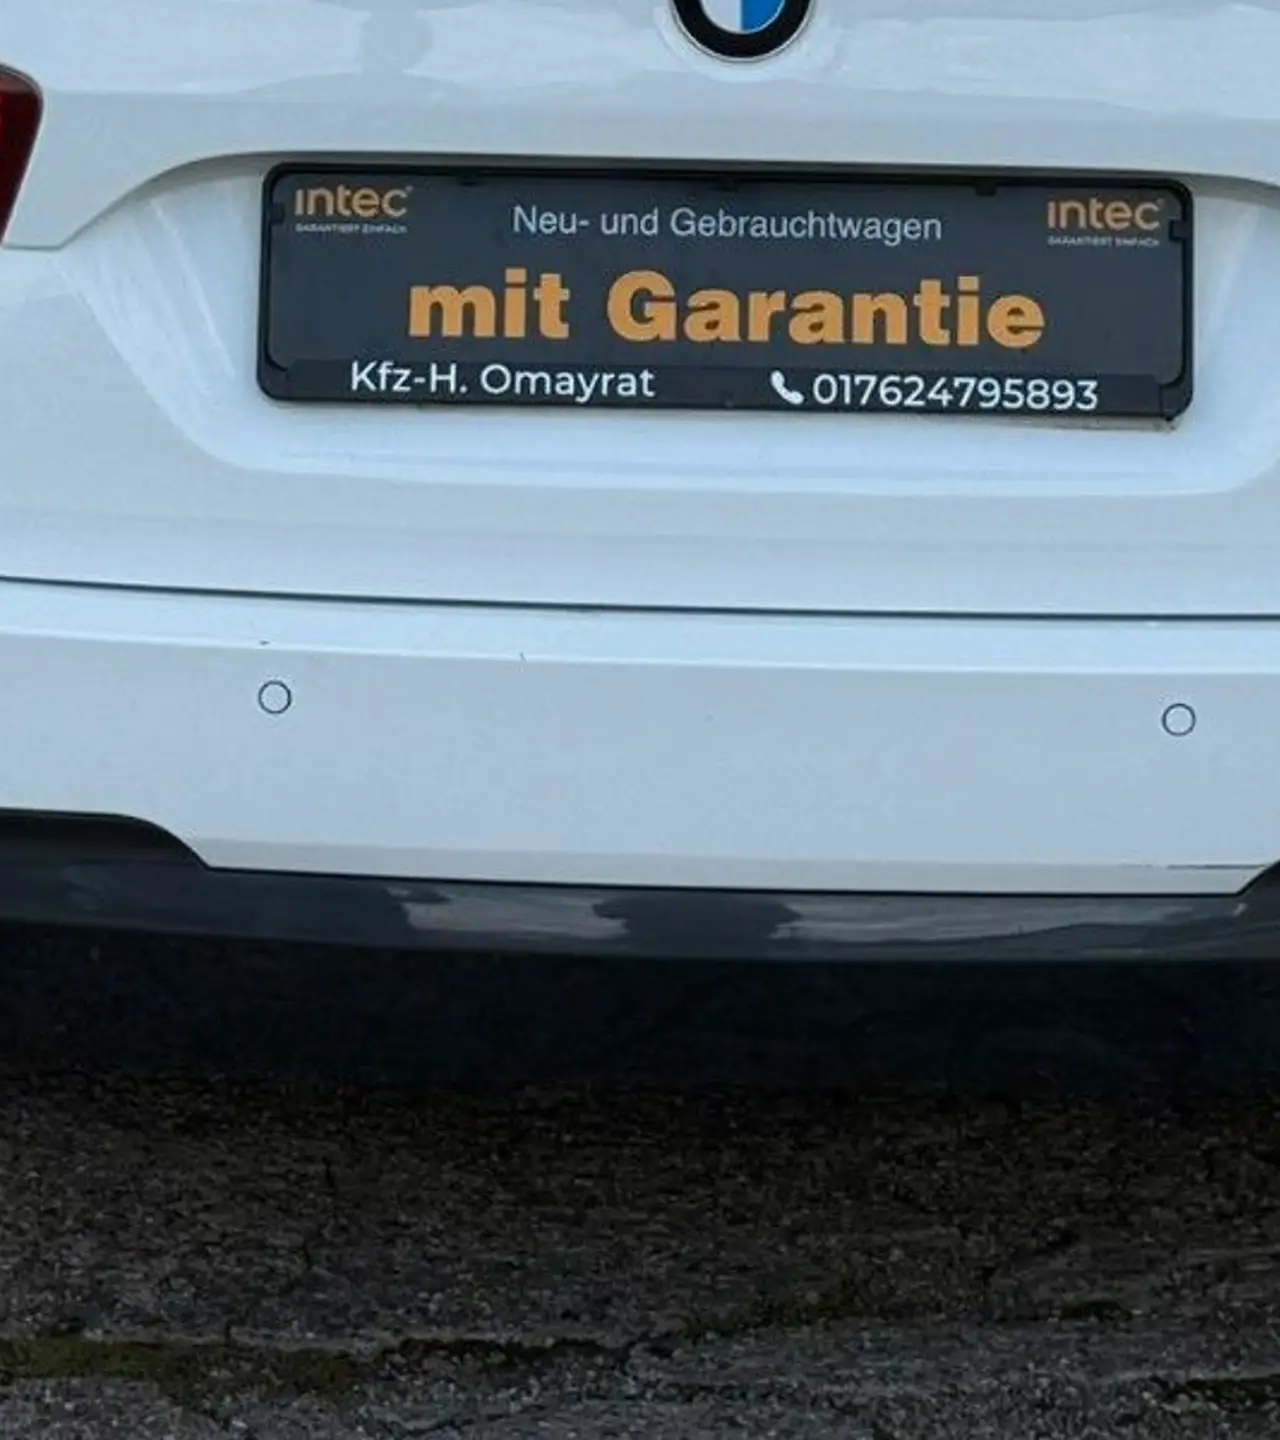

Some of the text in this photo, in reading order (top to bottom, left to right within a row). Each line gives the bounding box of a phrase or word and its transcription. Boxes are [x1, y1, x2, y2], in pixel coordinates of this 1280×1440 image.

[295, 184, 408, 217] intec
[1047, 197, 1160, 230] intec
[512, 205, 943, 247] Neu- und Gebrauchtwagen
[409, 268, 1046, 349] mit Garantie
[351, 361, 657, 403] Kfz-H. Omayrat
[812, 372, 1100, 411] 017624795893
